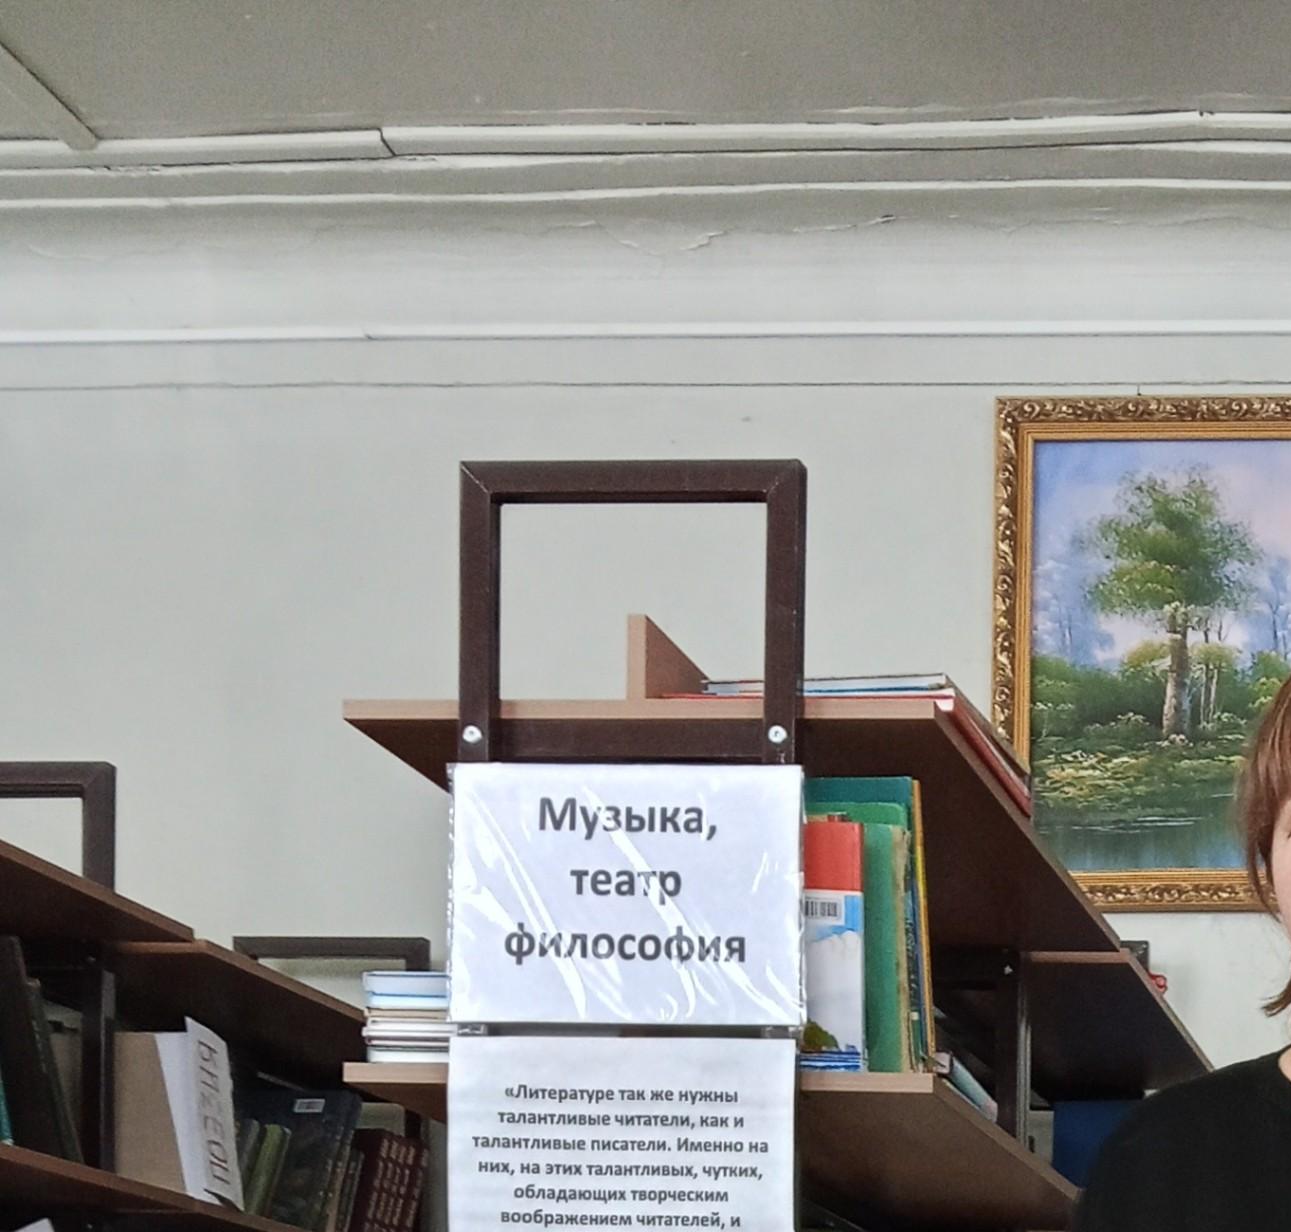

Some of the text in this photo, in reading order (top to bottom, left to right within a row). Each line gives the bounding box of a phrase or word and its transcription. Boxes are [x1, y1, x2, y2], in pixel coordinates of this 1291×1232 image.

[538, 796, 718, 841] Музыка,
[570, 867, 683, 905] театр
[504, 922, 747, 965] философия
[504, 1084, 739, 1105] «Литературе так же нужны
[498, 1111, 745, 1130] талантливые читатели, как и
[472, 1135, 769, 1154] талантливые писатели. Именно на
[478, 1161, 763, 1181] них, на этих талантливых, чутких,
[513, 1185, 729, 1205] обладающих творческим
[500, 1209, 741, 1231] воображением читателей, и
